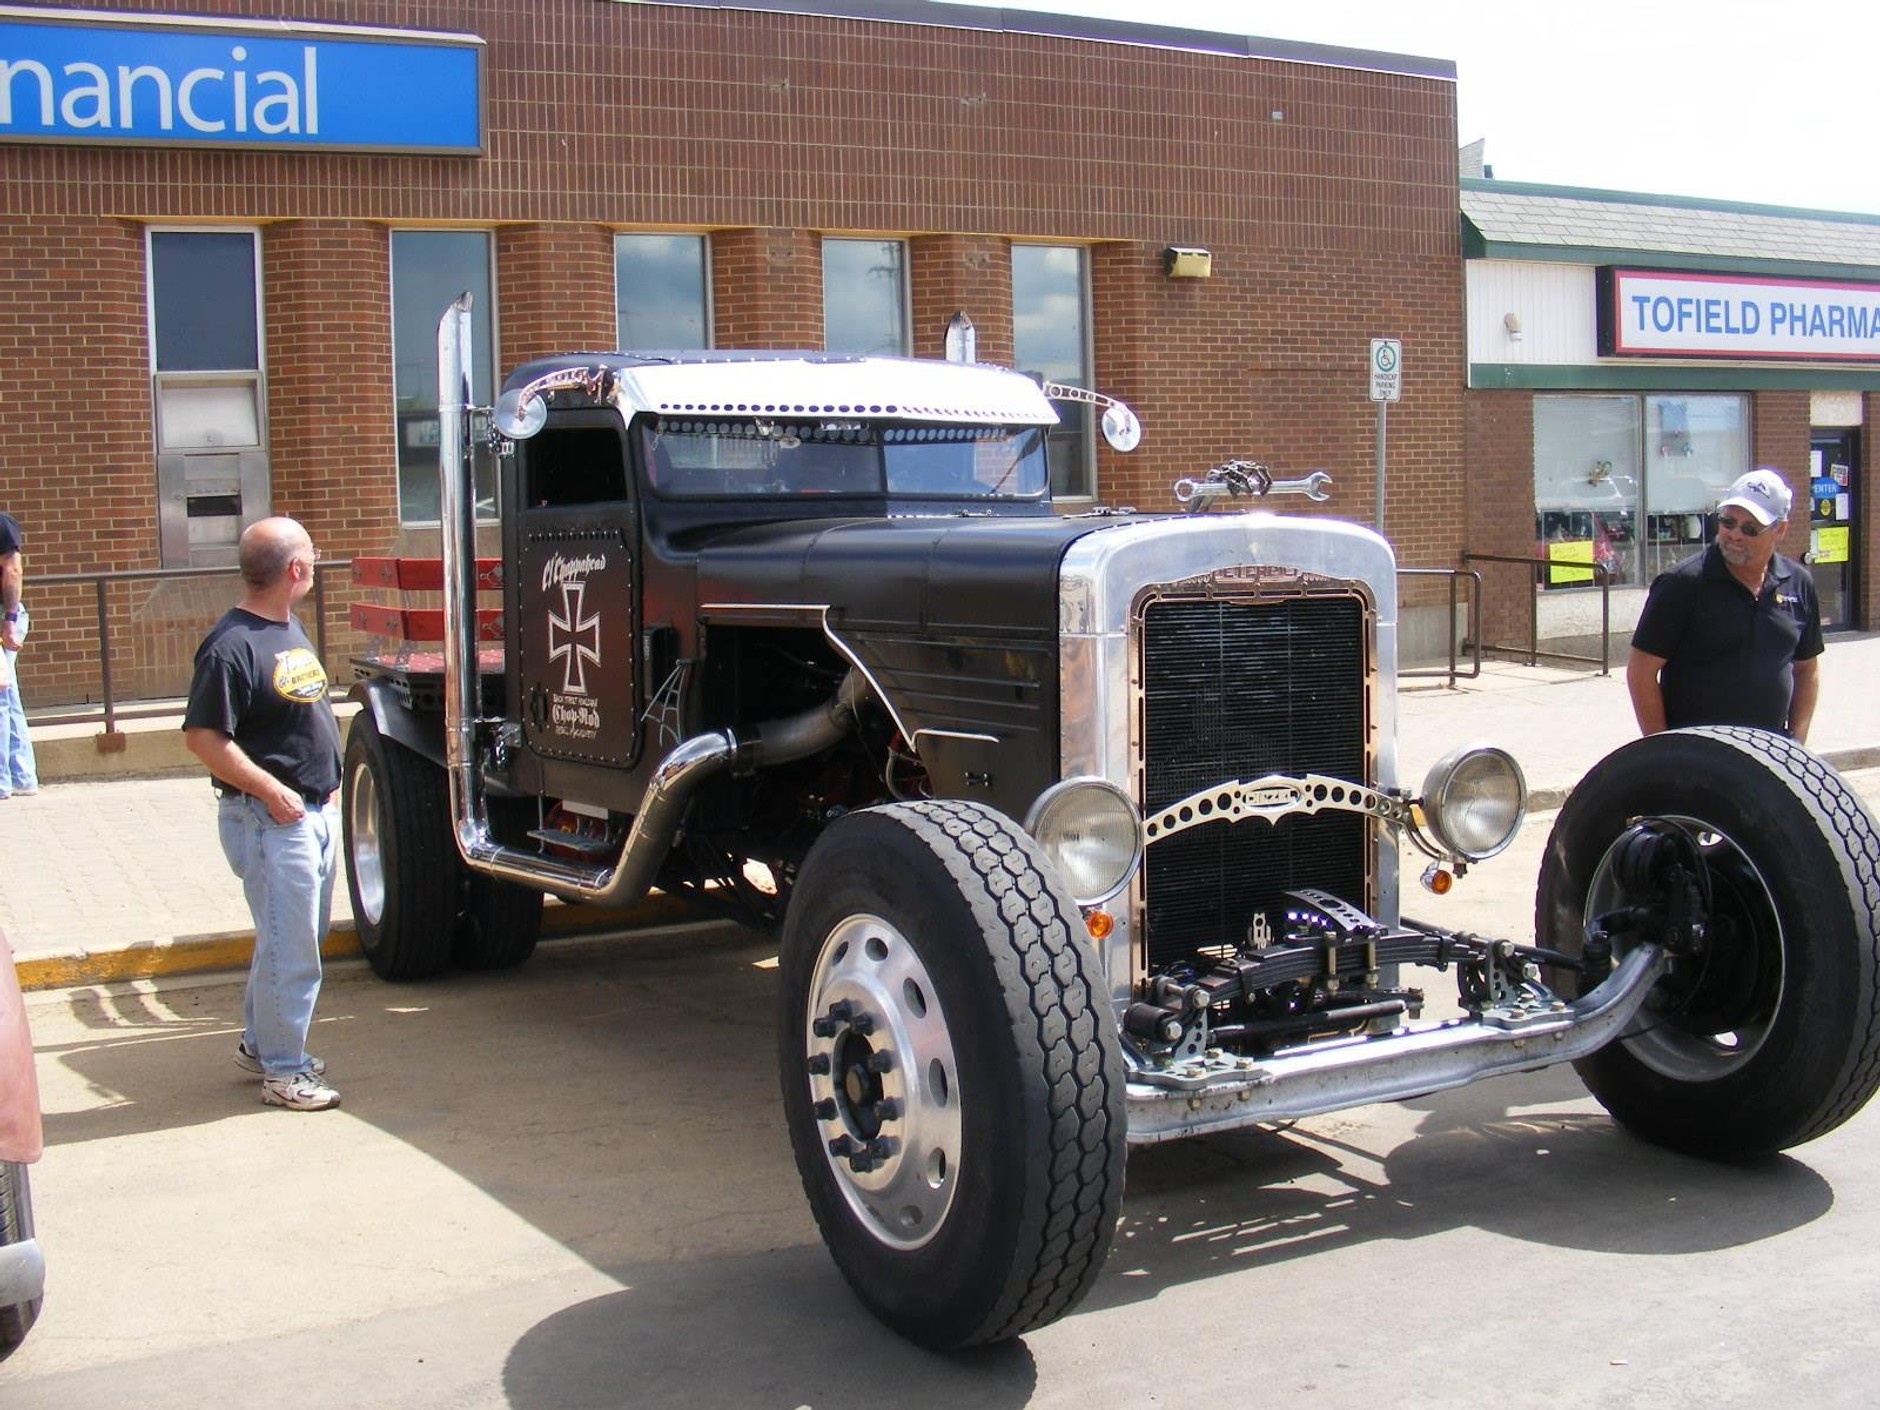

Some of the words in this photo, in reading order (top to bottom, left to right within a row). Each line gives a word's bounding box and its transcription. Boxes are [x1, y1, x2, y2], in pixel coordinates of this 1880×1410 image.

[0, 46, 319, 134] nancial
[1632, 296, 1760, 335] TOFIELD
[1814, 484, 1837, 493] ENTER
